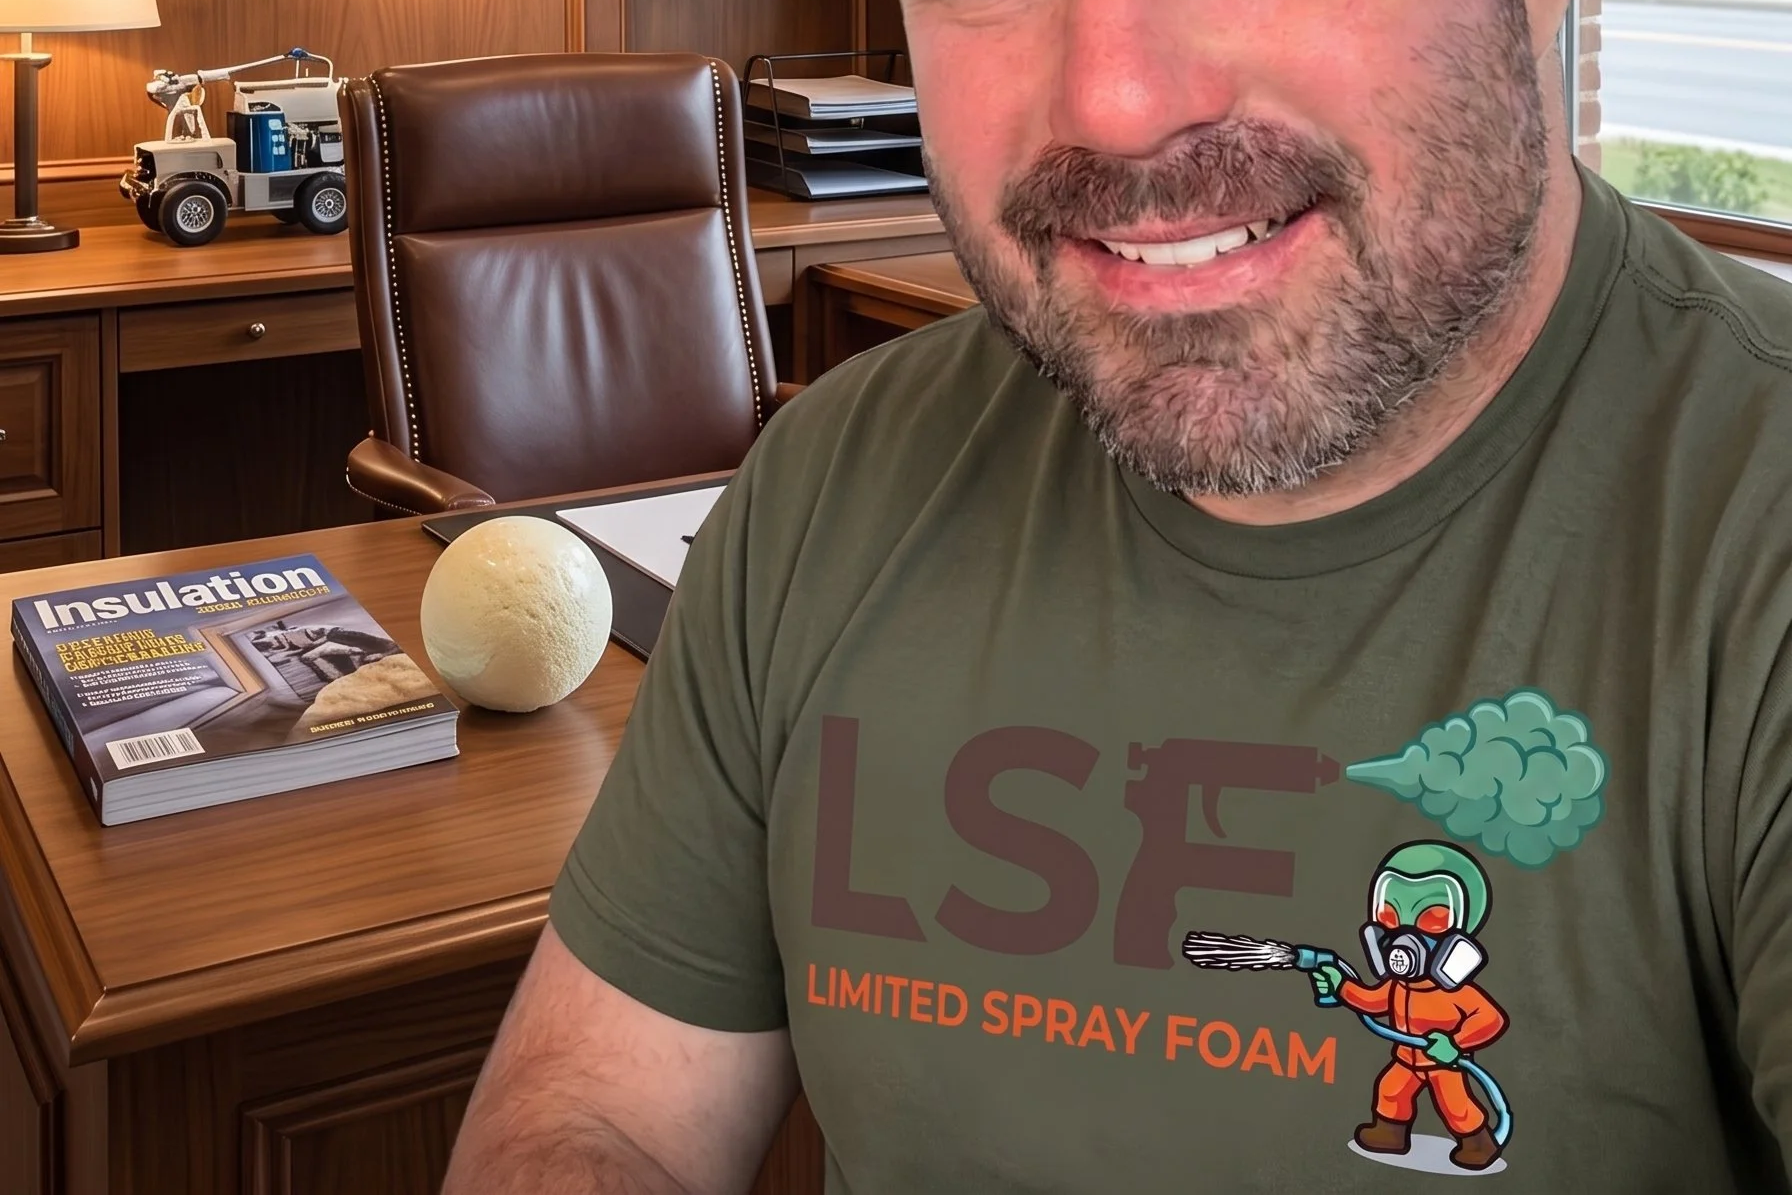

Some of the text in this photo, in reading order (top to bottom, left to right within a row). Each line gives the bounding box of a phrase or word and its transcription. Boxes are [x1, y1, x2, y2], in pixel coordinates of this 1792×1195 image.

[34, 566, 325, 630] Insulation
[810, 714, 1341, 972] LSF
[806, 963, 1338, 1085] LIMITED SPRAY FOAM
